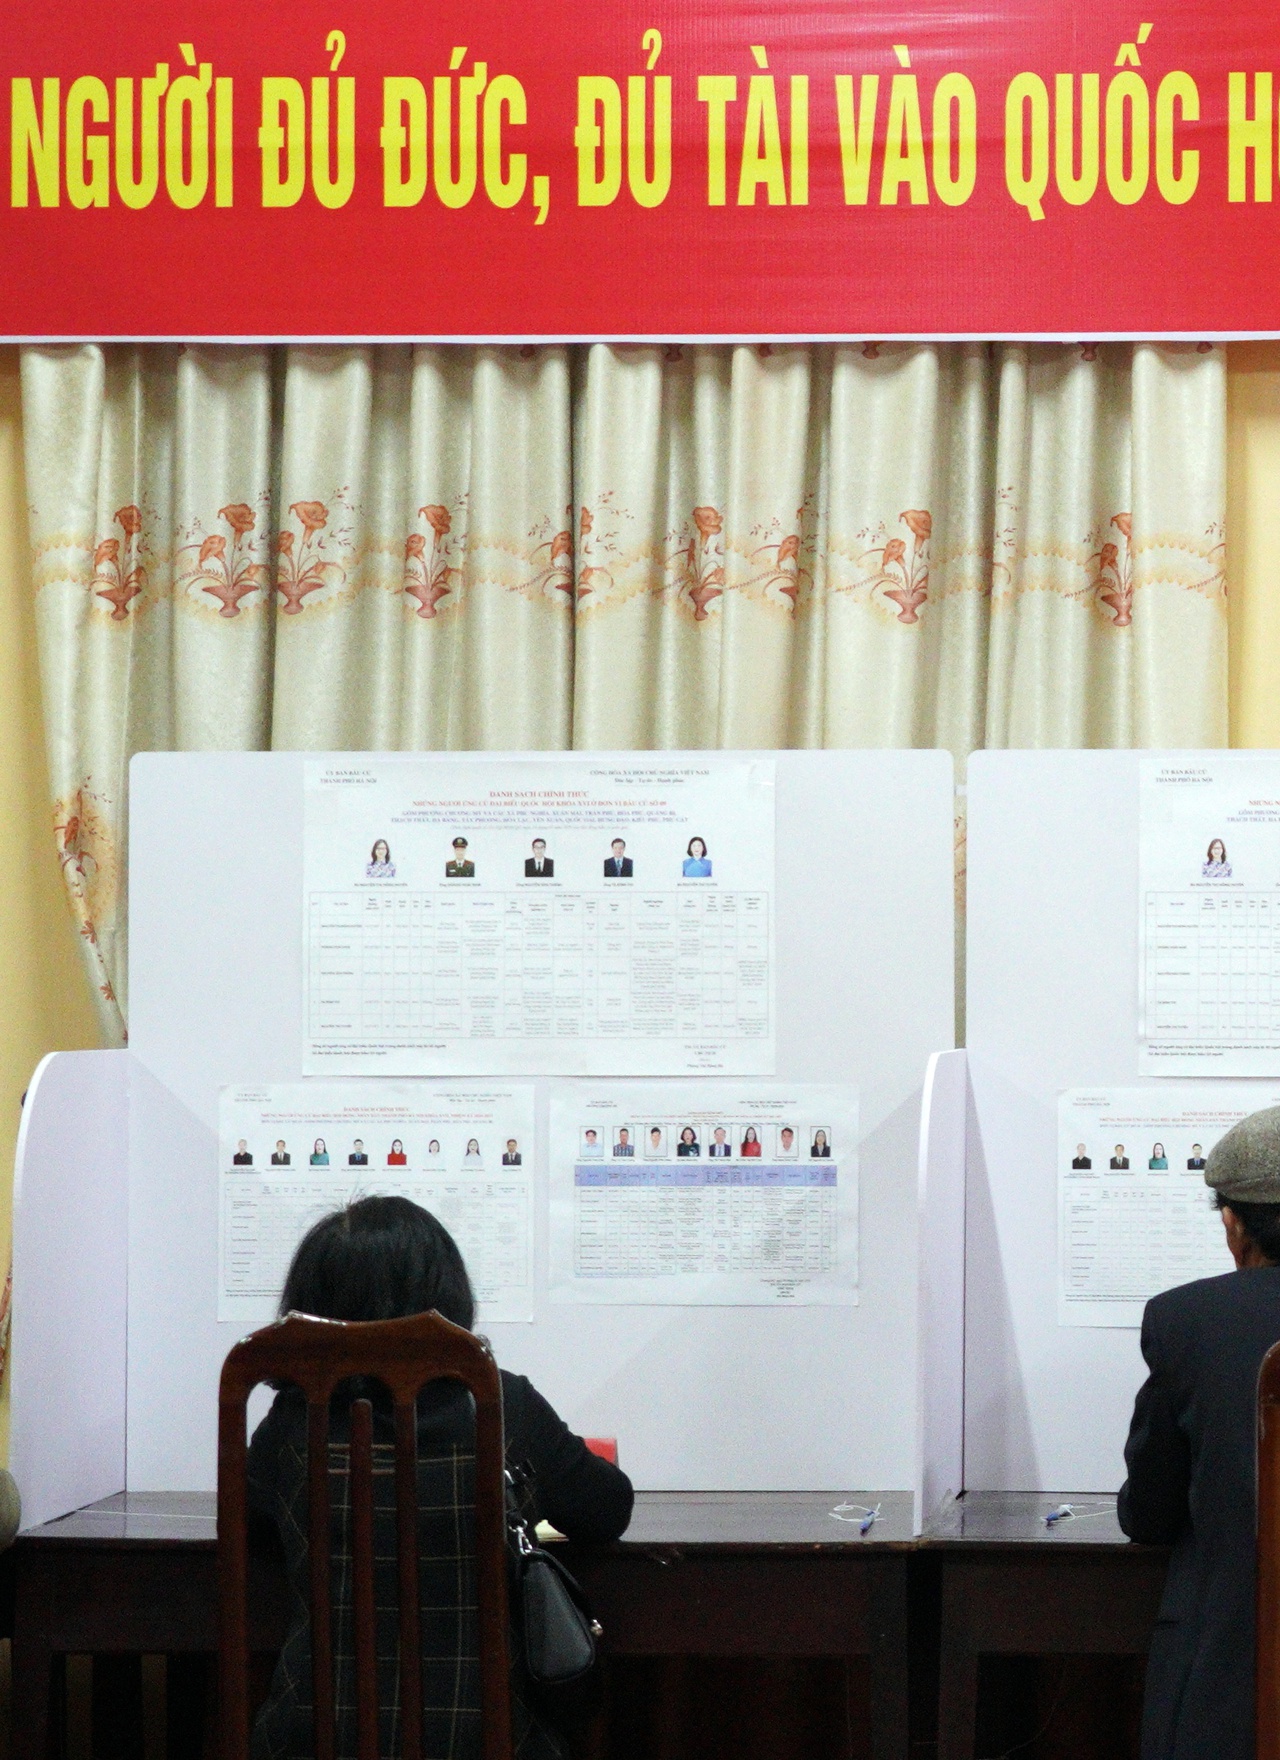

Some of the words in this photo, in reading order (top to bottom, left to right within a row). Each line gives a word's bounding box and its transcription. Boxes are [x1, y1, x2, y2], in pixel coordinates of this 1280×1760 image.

[12, 44, 232, 209] NGƯỜI
[259, 30, 355, 209] ĐỦ
[380, 47, 549, 225] ĐỨC,
[575, 29, 671, 208] ĐỦ
[698, 46, 808, 205] TÀI
[835, 45, 976, 206] VÀO
[1005, 23, 1199, 221] QUỐC
